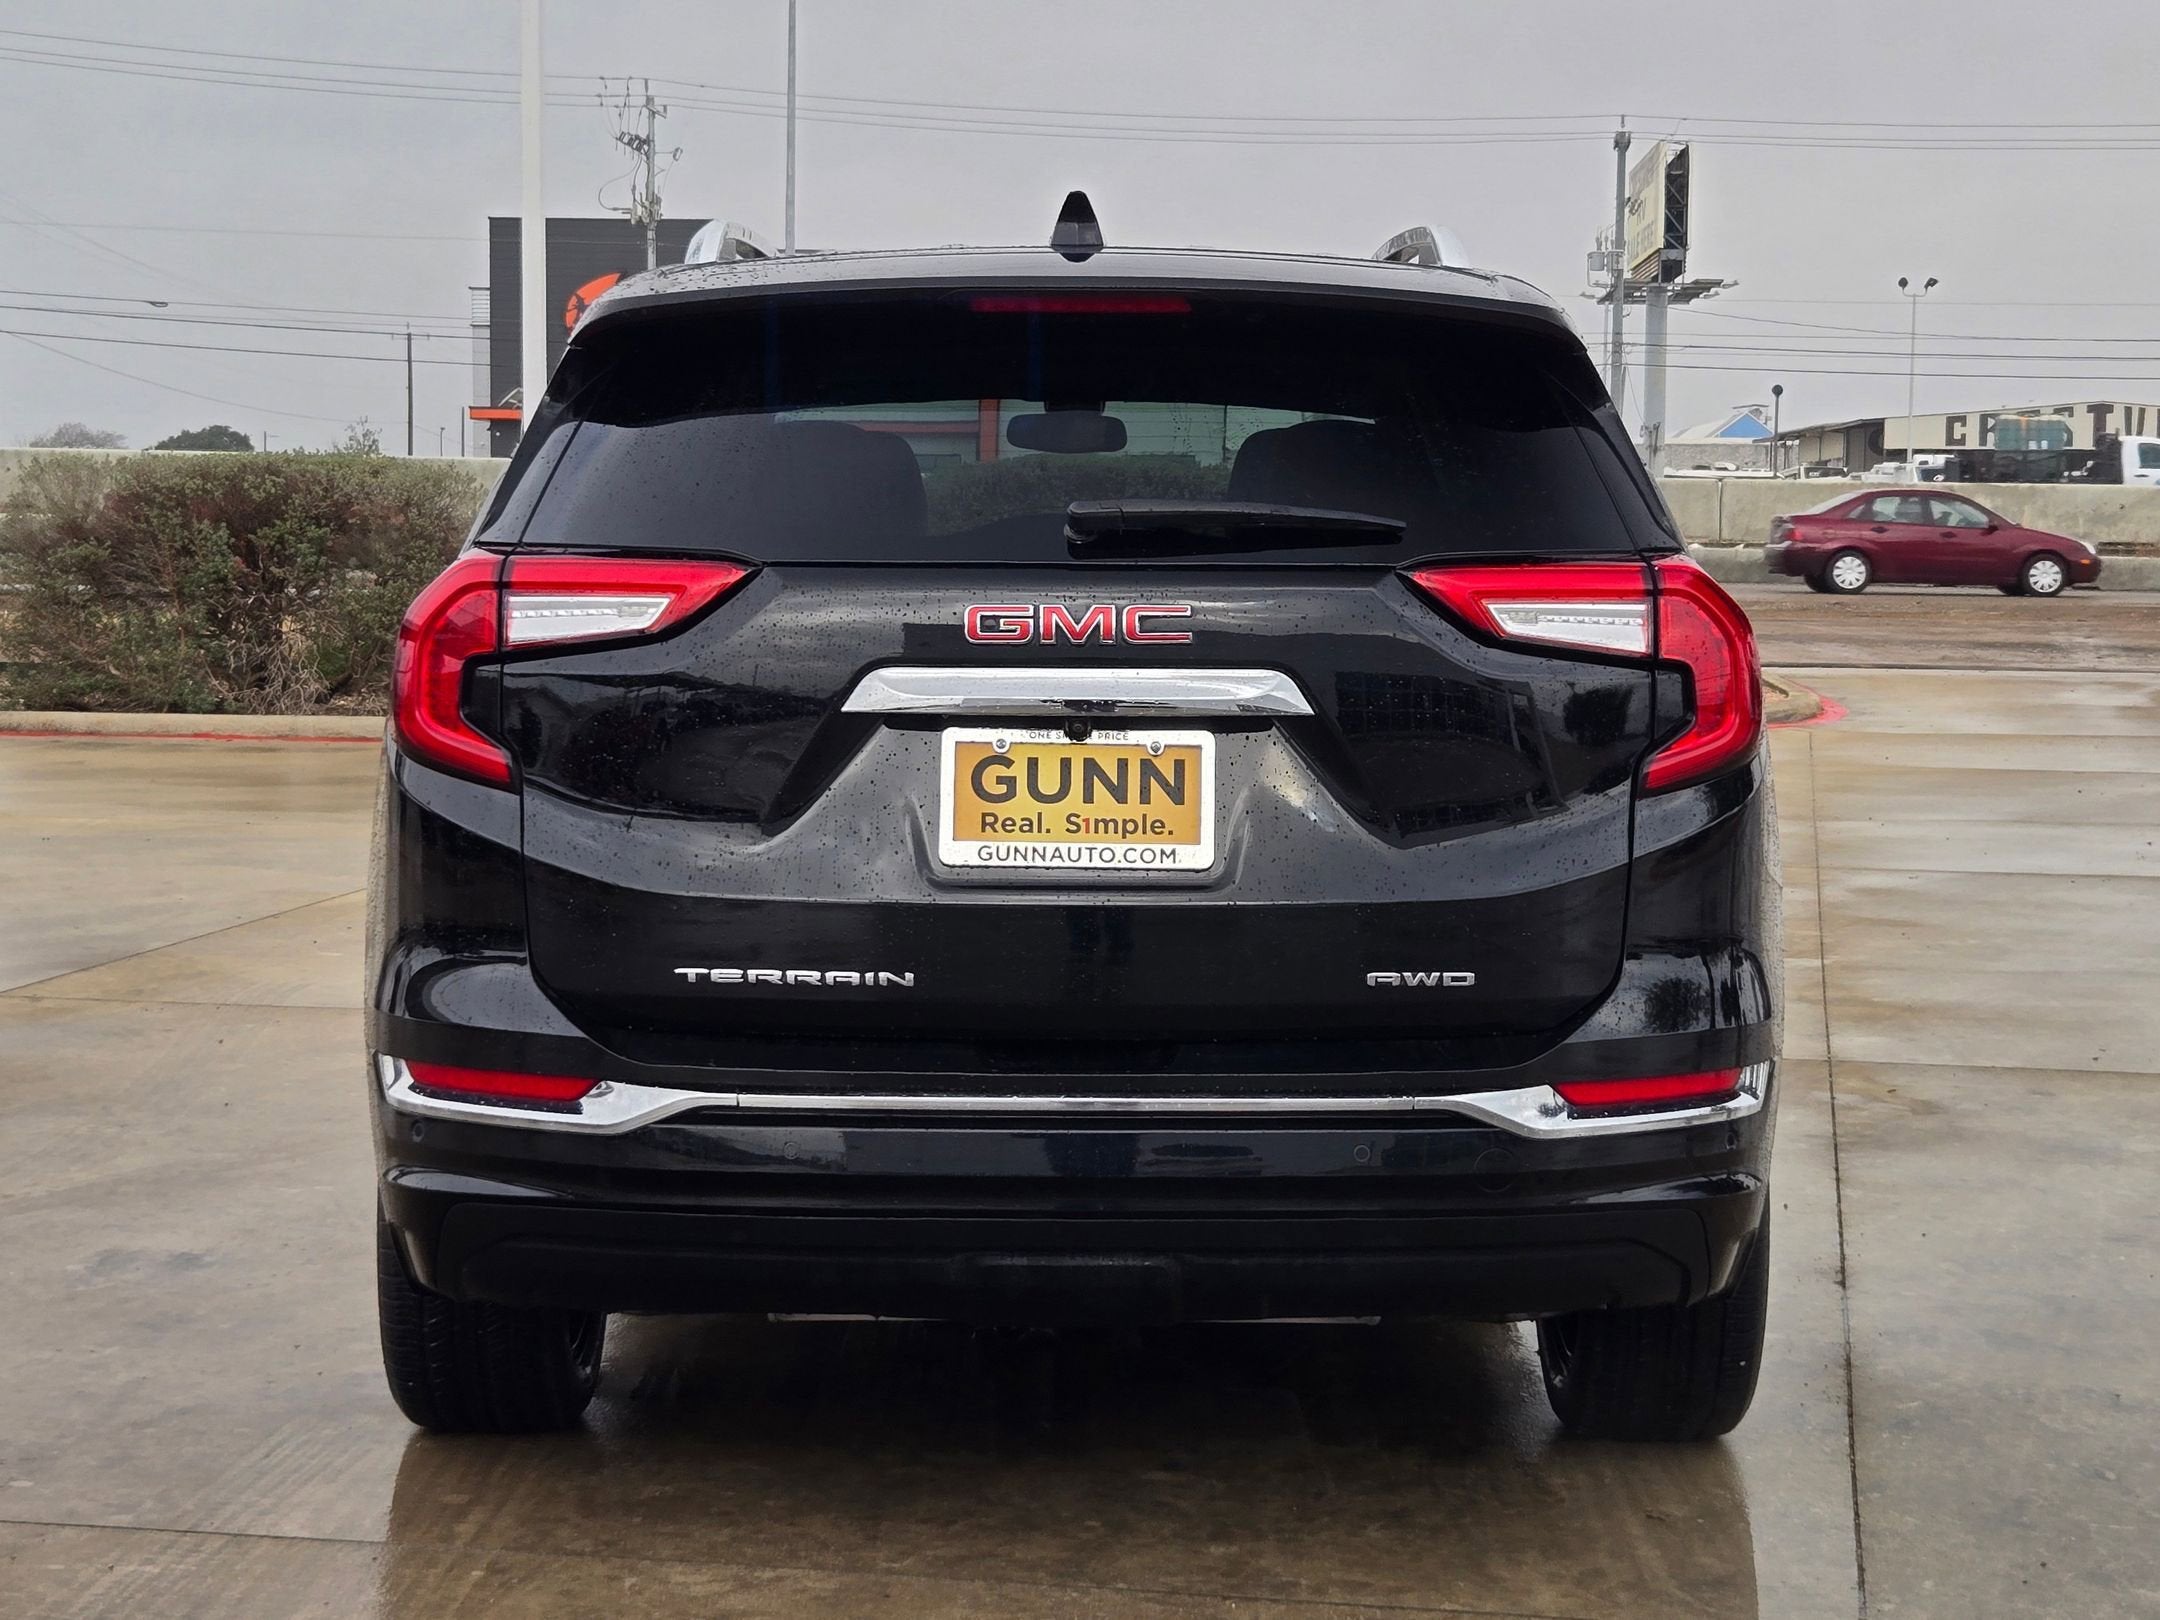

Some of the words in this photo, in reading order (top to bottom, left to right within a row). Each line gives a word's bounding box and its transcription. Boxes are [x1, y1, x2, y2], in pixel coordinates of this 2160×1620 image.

[1945, 404, 2160, 448] CRTV
[964, 604, 1193, 645] GMC
[1028, 731, 1053, 740] ONE
[1097, 732, 1129, 741] PRICE
[970, 754, 1186, 806] GUNN
[980, 812, 1051, 834] Real.
[977, 845, 1177, 865] GUNNAUTO.COM
[673, 967, 915, 987] TERRAIN
[1366, 971, 1475, 987] AWD
